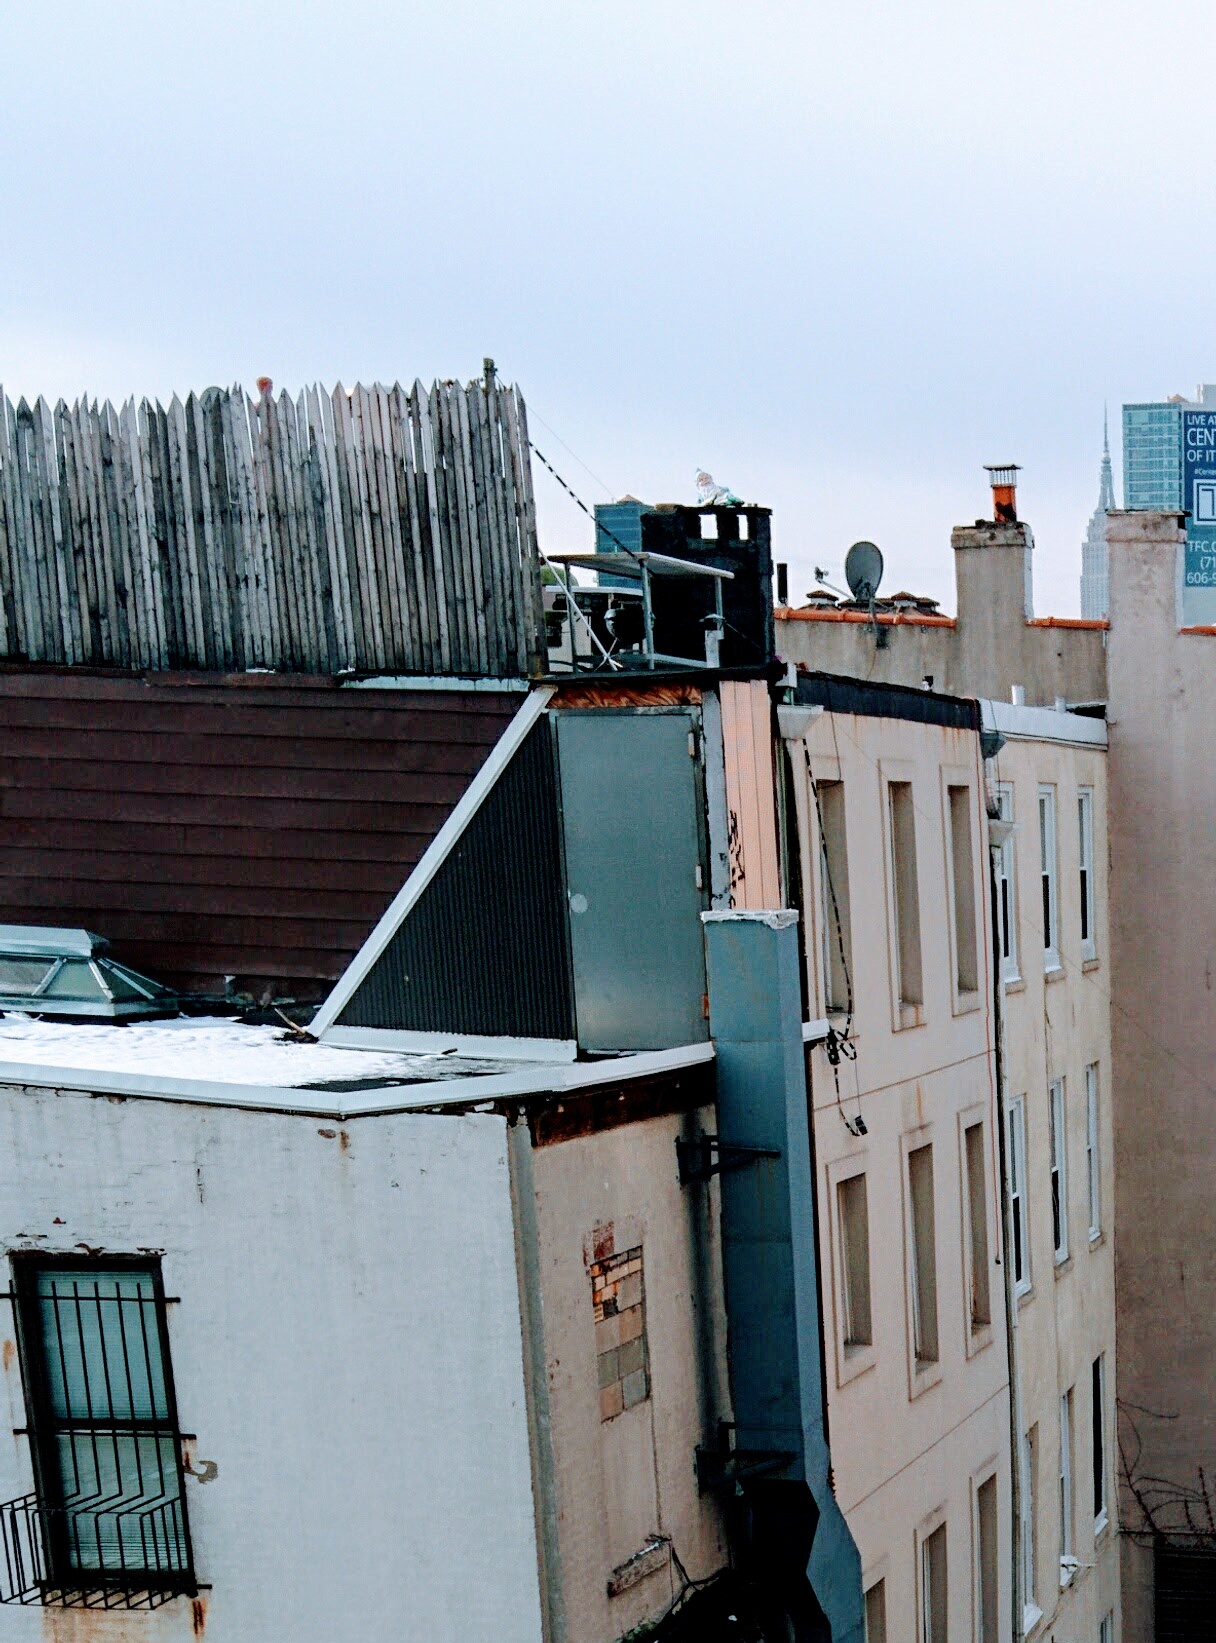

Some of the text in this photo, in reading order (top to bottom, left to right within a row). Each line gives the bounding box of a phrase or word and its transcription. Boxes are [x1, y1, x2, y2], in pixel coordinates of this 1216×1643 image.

[1187, 415, 1206, 426] LIVE
[1187, 449, 1202, 462] OF
[1206, 450, 1216, 462] IT
